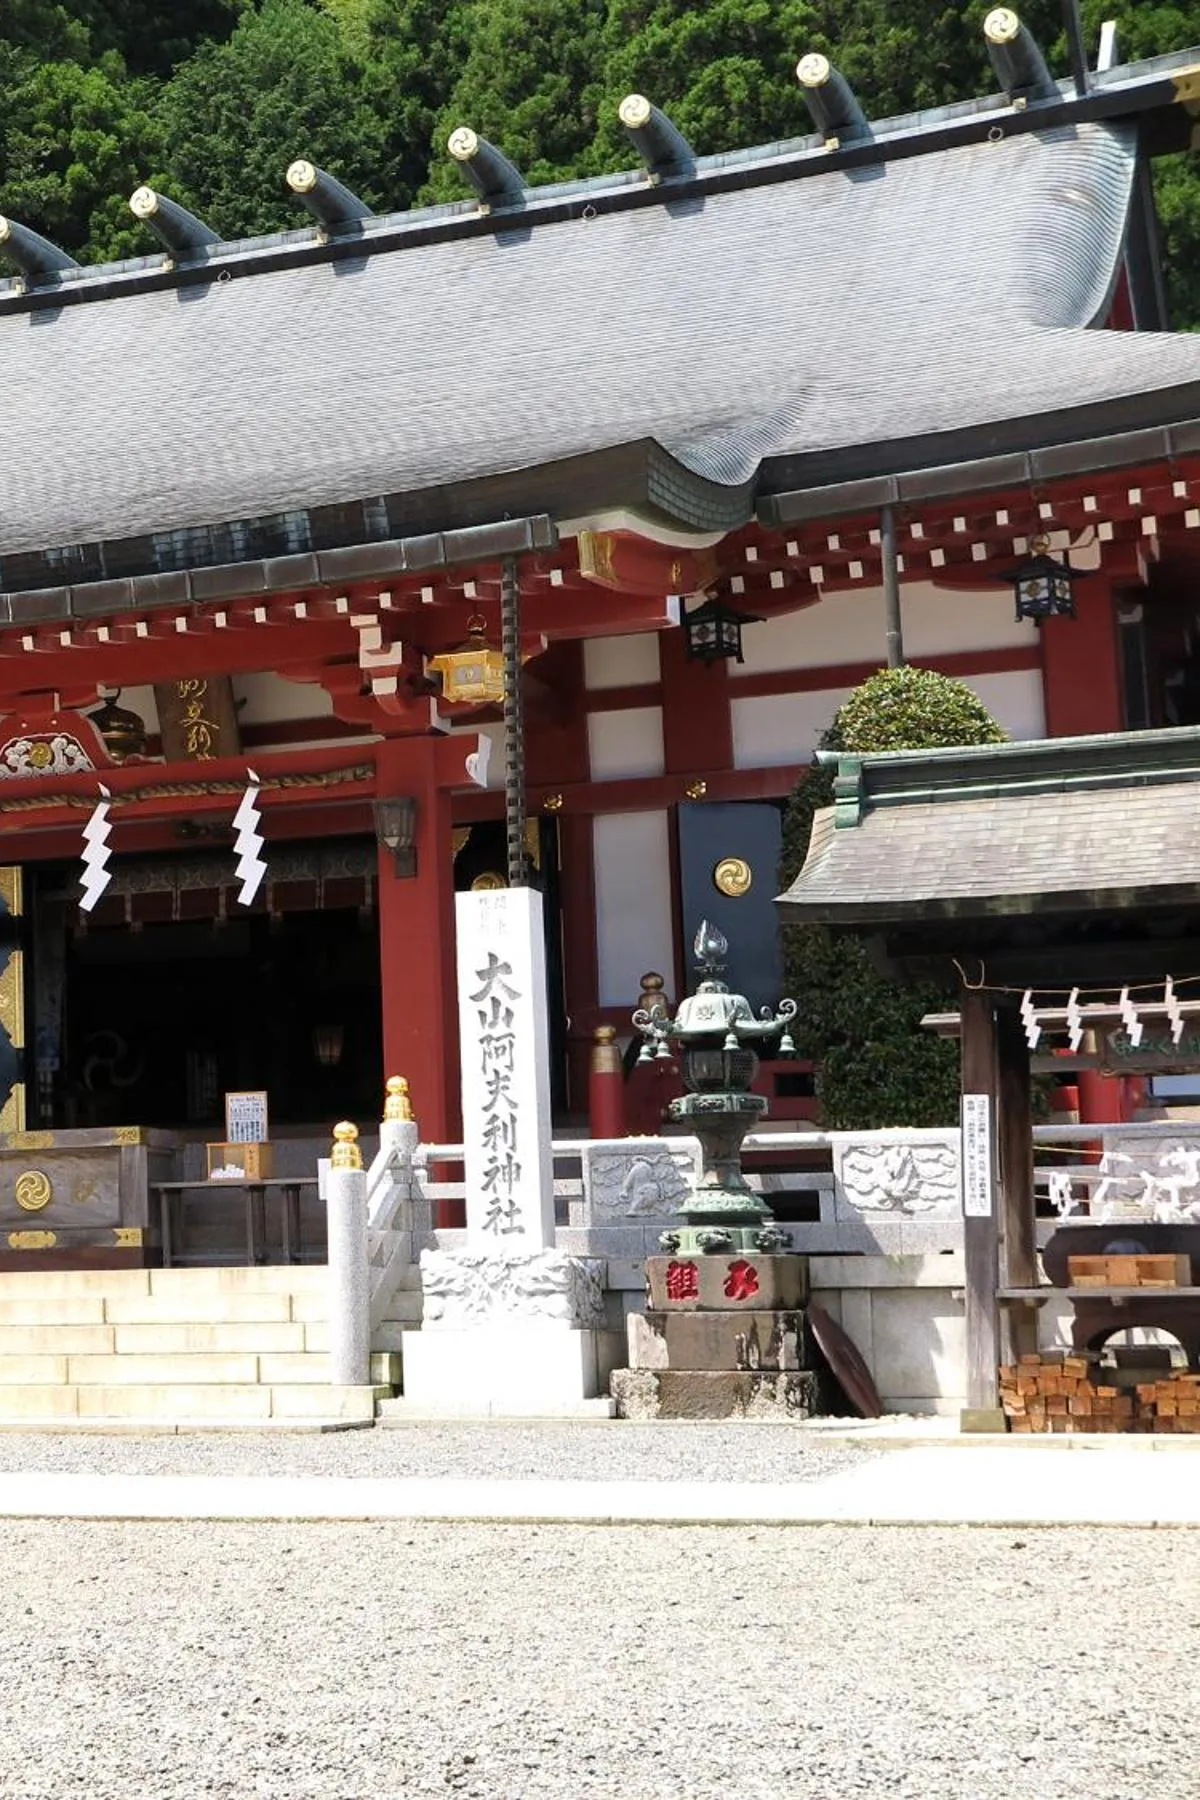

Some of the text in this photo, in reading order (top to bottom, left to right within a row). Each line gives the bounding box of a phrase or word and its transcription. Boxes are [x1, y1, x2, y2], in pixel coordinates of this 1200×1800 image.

[176, 679, 220, 761] 阿夫利
[468, 951, 526, 1237] 大山阿夫利神社
